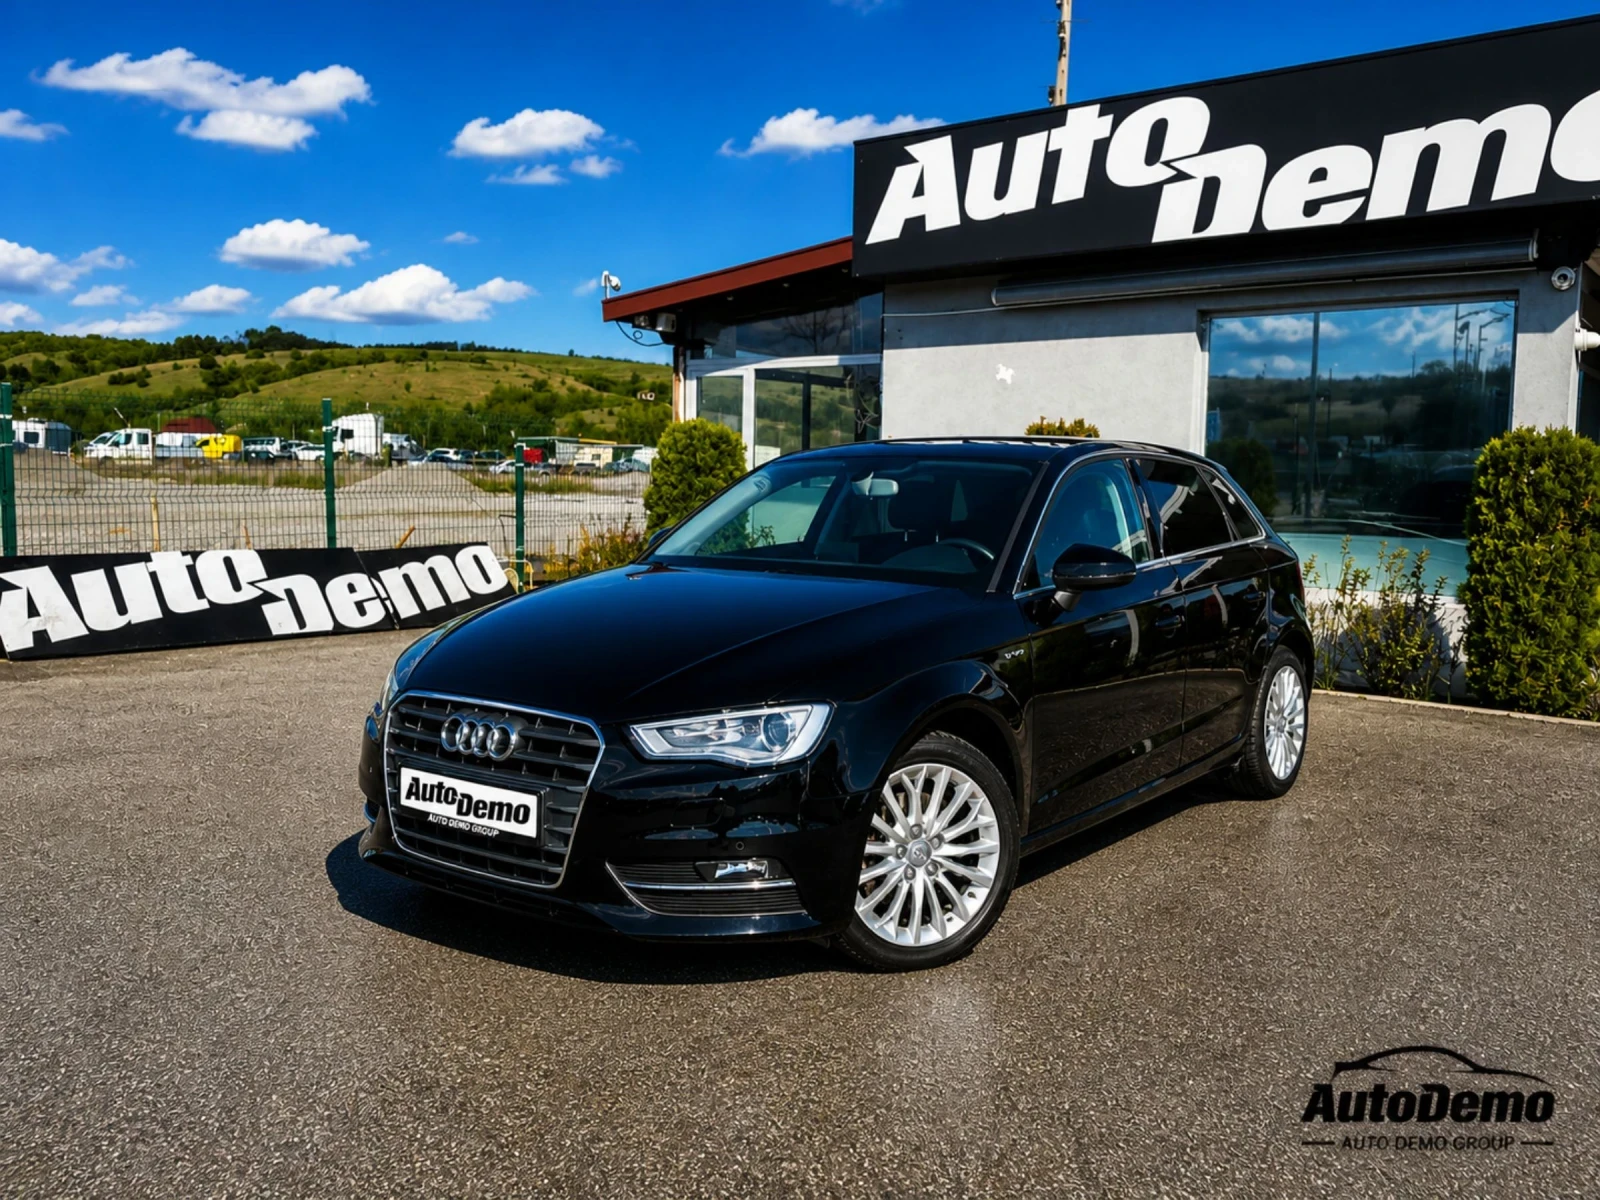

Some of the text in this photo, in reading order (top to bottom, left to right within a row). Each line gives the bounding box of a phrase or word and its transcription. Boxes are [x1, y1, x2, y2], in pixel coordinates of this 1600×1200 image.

[427, 814, 500, 838] AUTO DEMO GROUP
